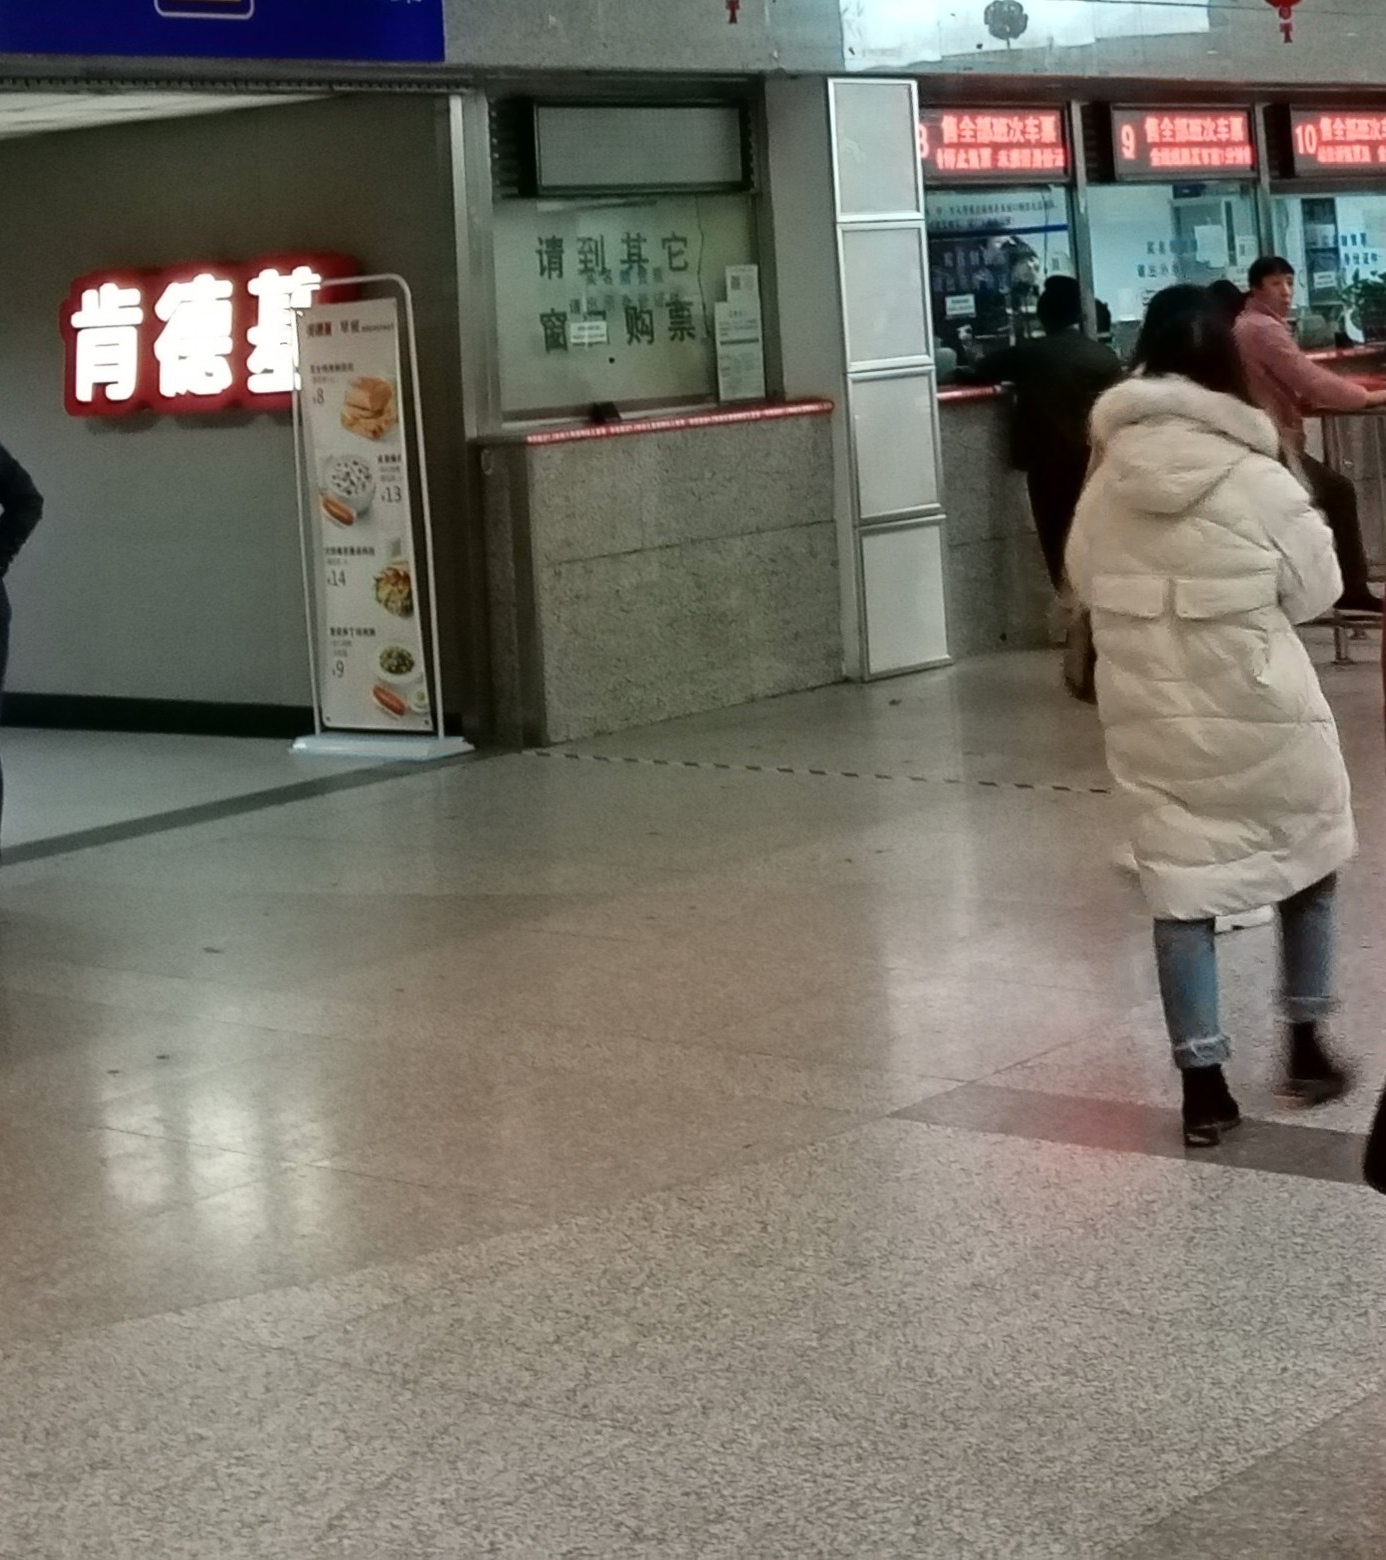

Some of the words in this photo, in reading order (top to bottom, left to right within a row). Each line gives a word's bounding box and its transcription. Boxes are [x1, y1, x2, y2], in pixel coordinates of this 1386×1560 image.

[1121, 125, 1135, 159] 9
[1296, 124, 1317, 154] 10
[536, 231, 689, 280] 请到其它
[539, 295, 697, 354] 窗购票
